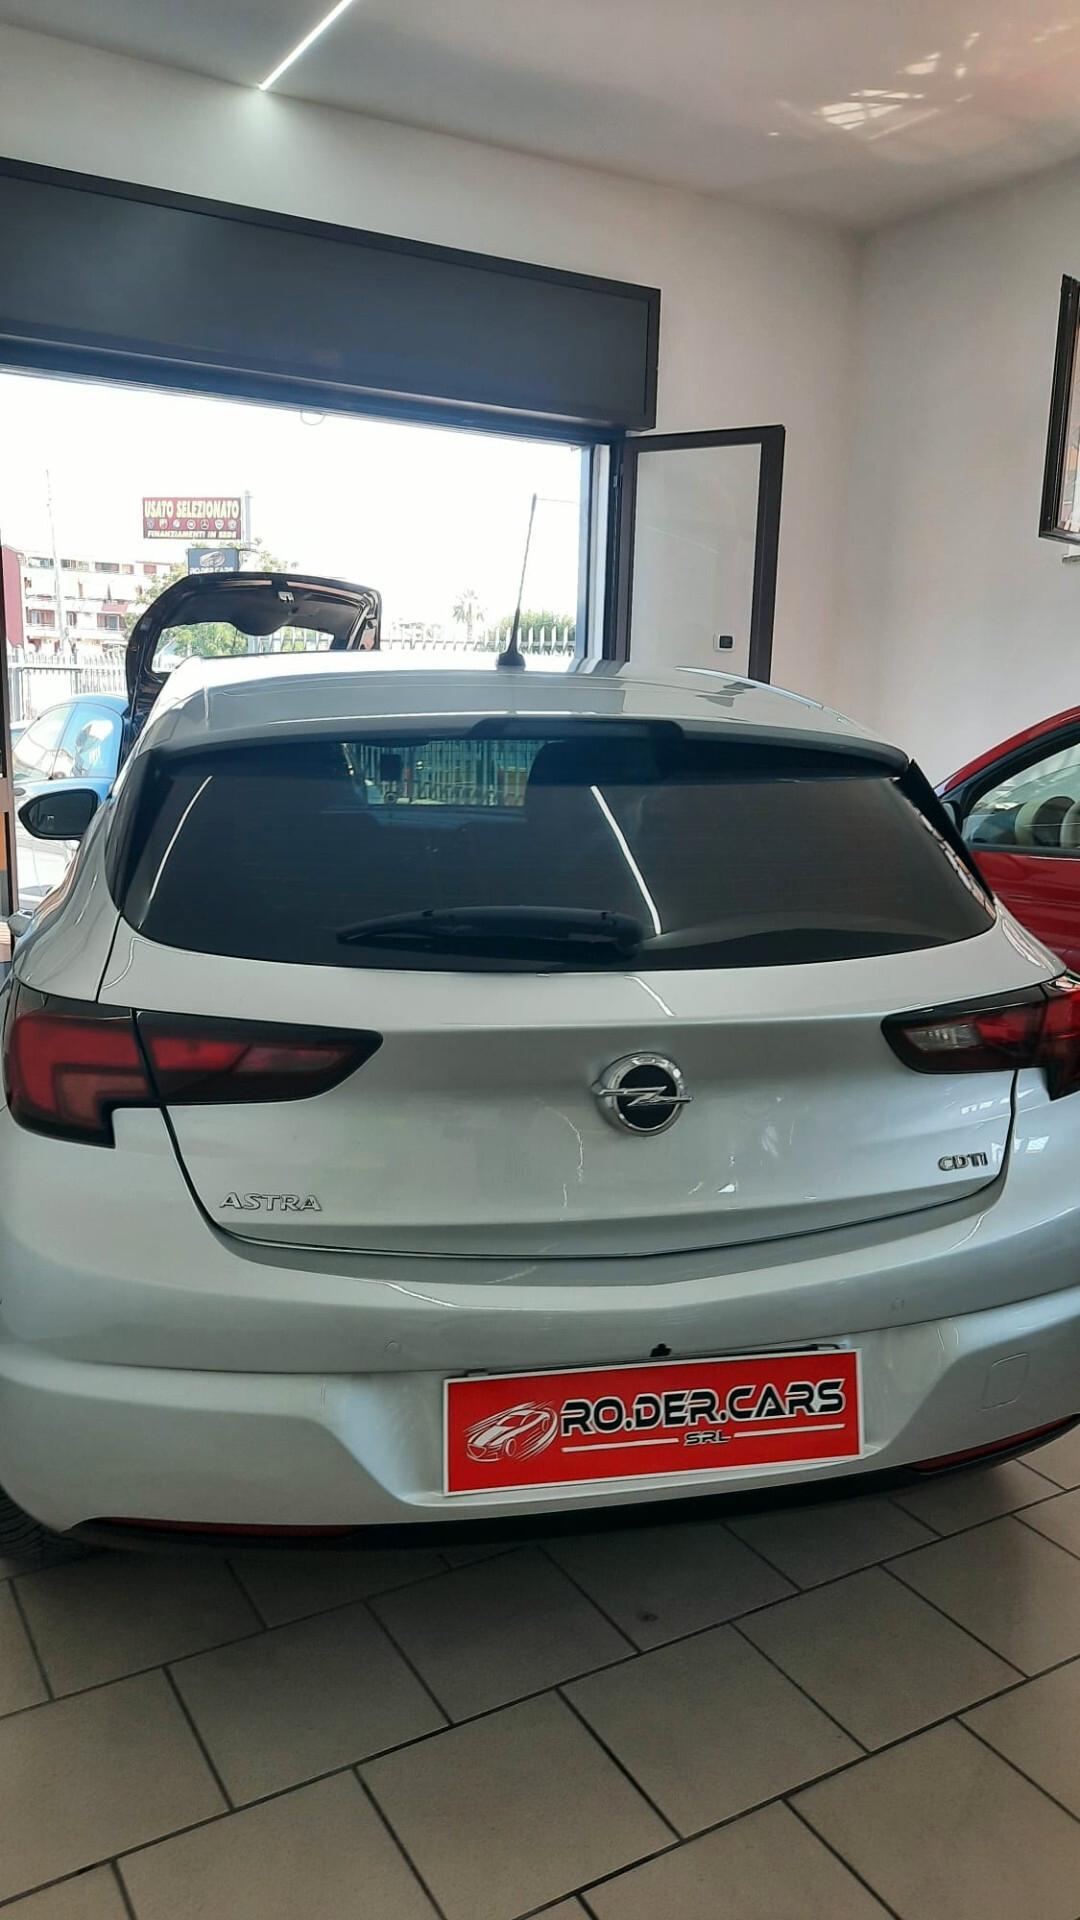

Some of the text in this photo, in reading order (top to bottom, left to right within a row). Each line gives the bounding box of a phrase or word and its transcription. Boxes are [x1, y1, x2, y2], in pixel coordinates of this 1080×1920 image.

[144, 500, 239, 518] USATO SELEZIONATO
[147, 530, 206, 538] FINANZIAMENTI
[207, 530, 217, 538] IN
[938, 1152, 988, 1171] CDTI
[220, 1192, 322, 1211] ASTRA
[561, 1379, 846, 1436] RO.DER.CARS
[683, 1430, 732, 1447] SRL
